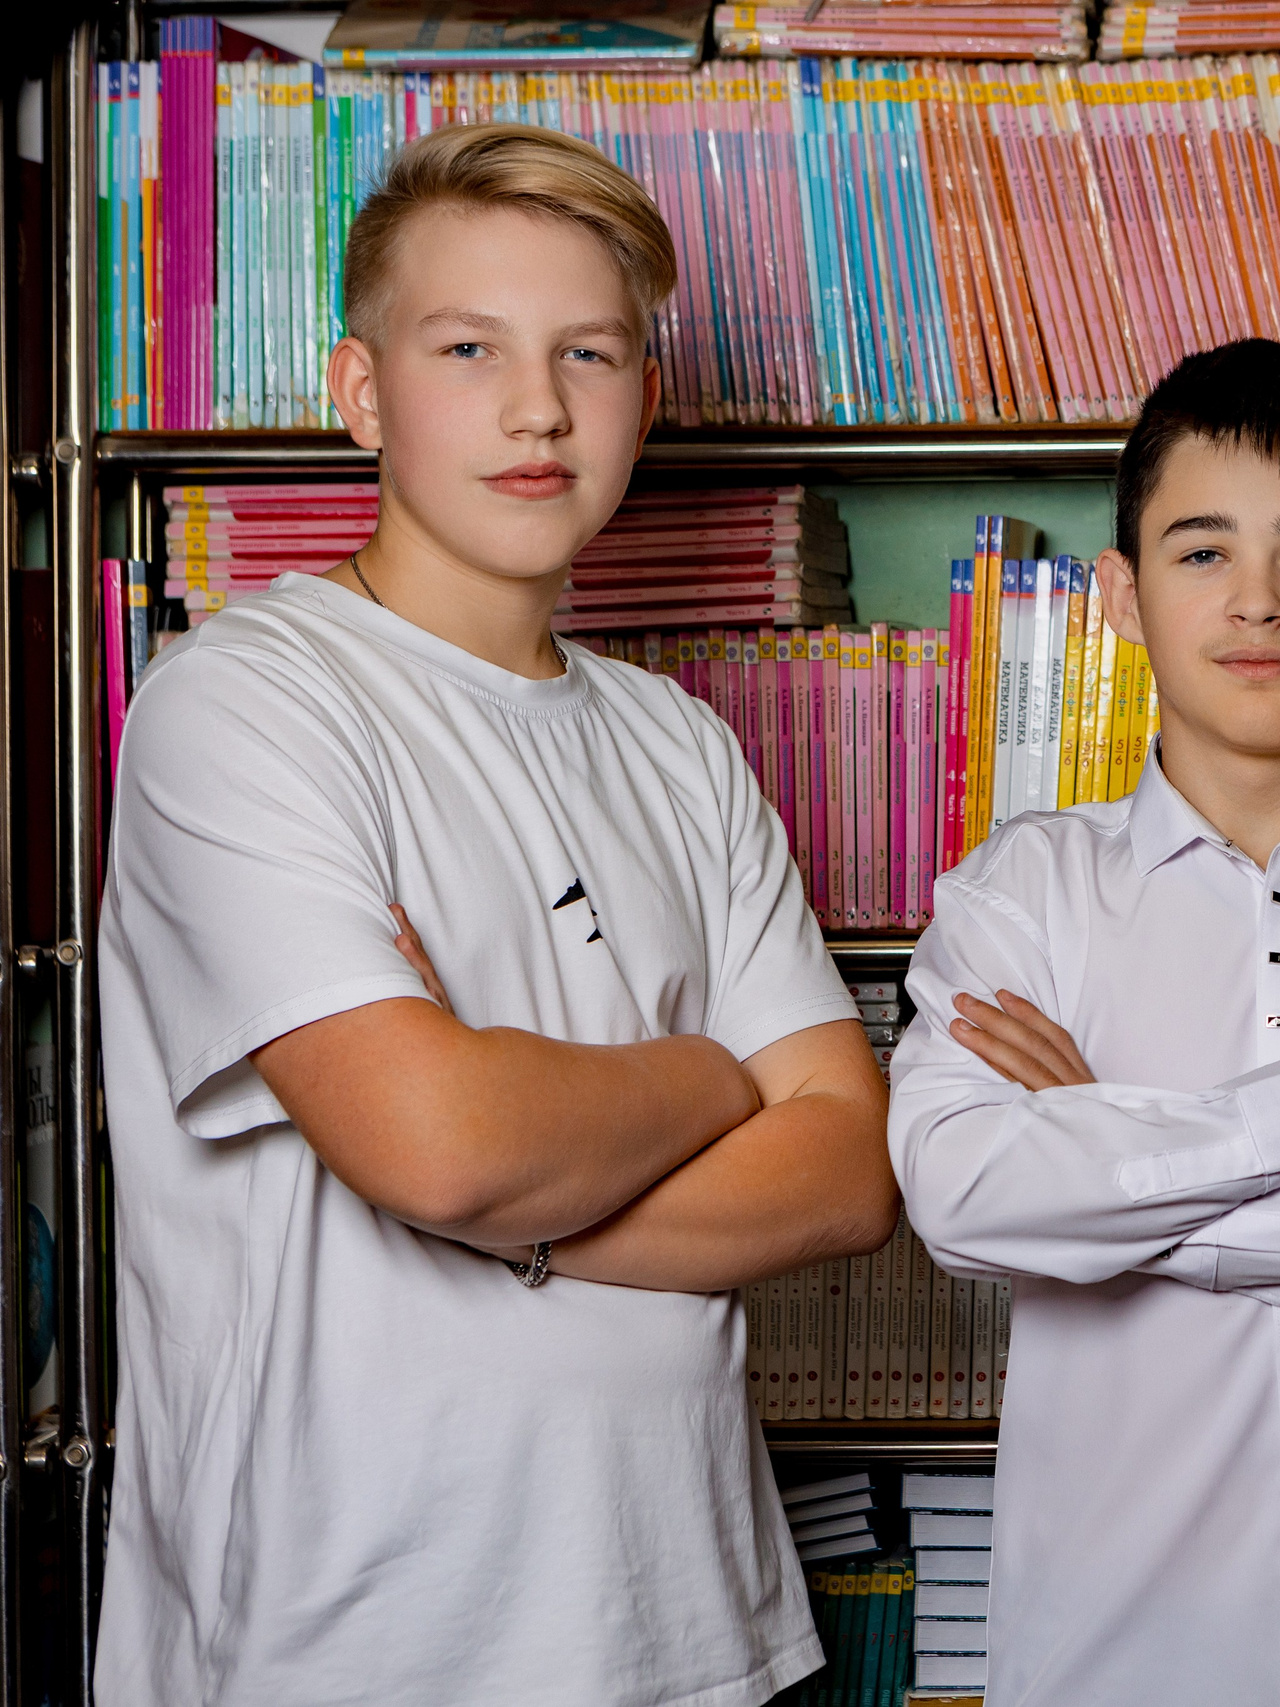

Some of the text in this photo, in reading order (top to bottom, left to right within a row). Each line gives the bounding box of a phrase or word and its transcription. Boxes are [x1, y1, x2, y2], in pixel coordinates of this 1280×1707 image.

[1118, 665, 1131, 718] География
[1136, 662, 1149, 715] География
[999, 661, 1011, 745] МАТЕМАТИКА
[1017, 661, 1029, 746] МАТЕМАТИКА
[1049, 658, 1062, 742] МАТЕМАТИКА
[1116, 739, 1124, 750] 5
[1134, 736, 1143, 748] 5
[1115, 755, 1123, 766] 6
[1133, 752, 1141, 763] 6
[947, 770, 955, 781] 4
[959, 771, 966, 782] 4
[889, 1634, 896, 1647] 7
